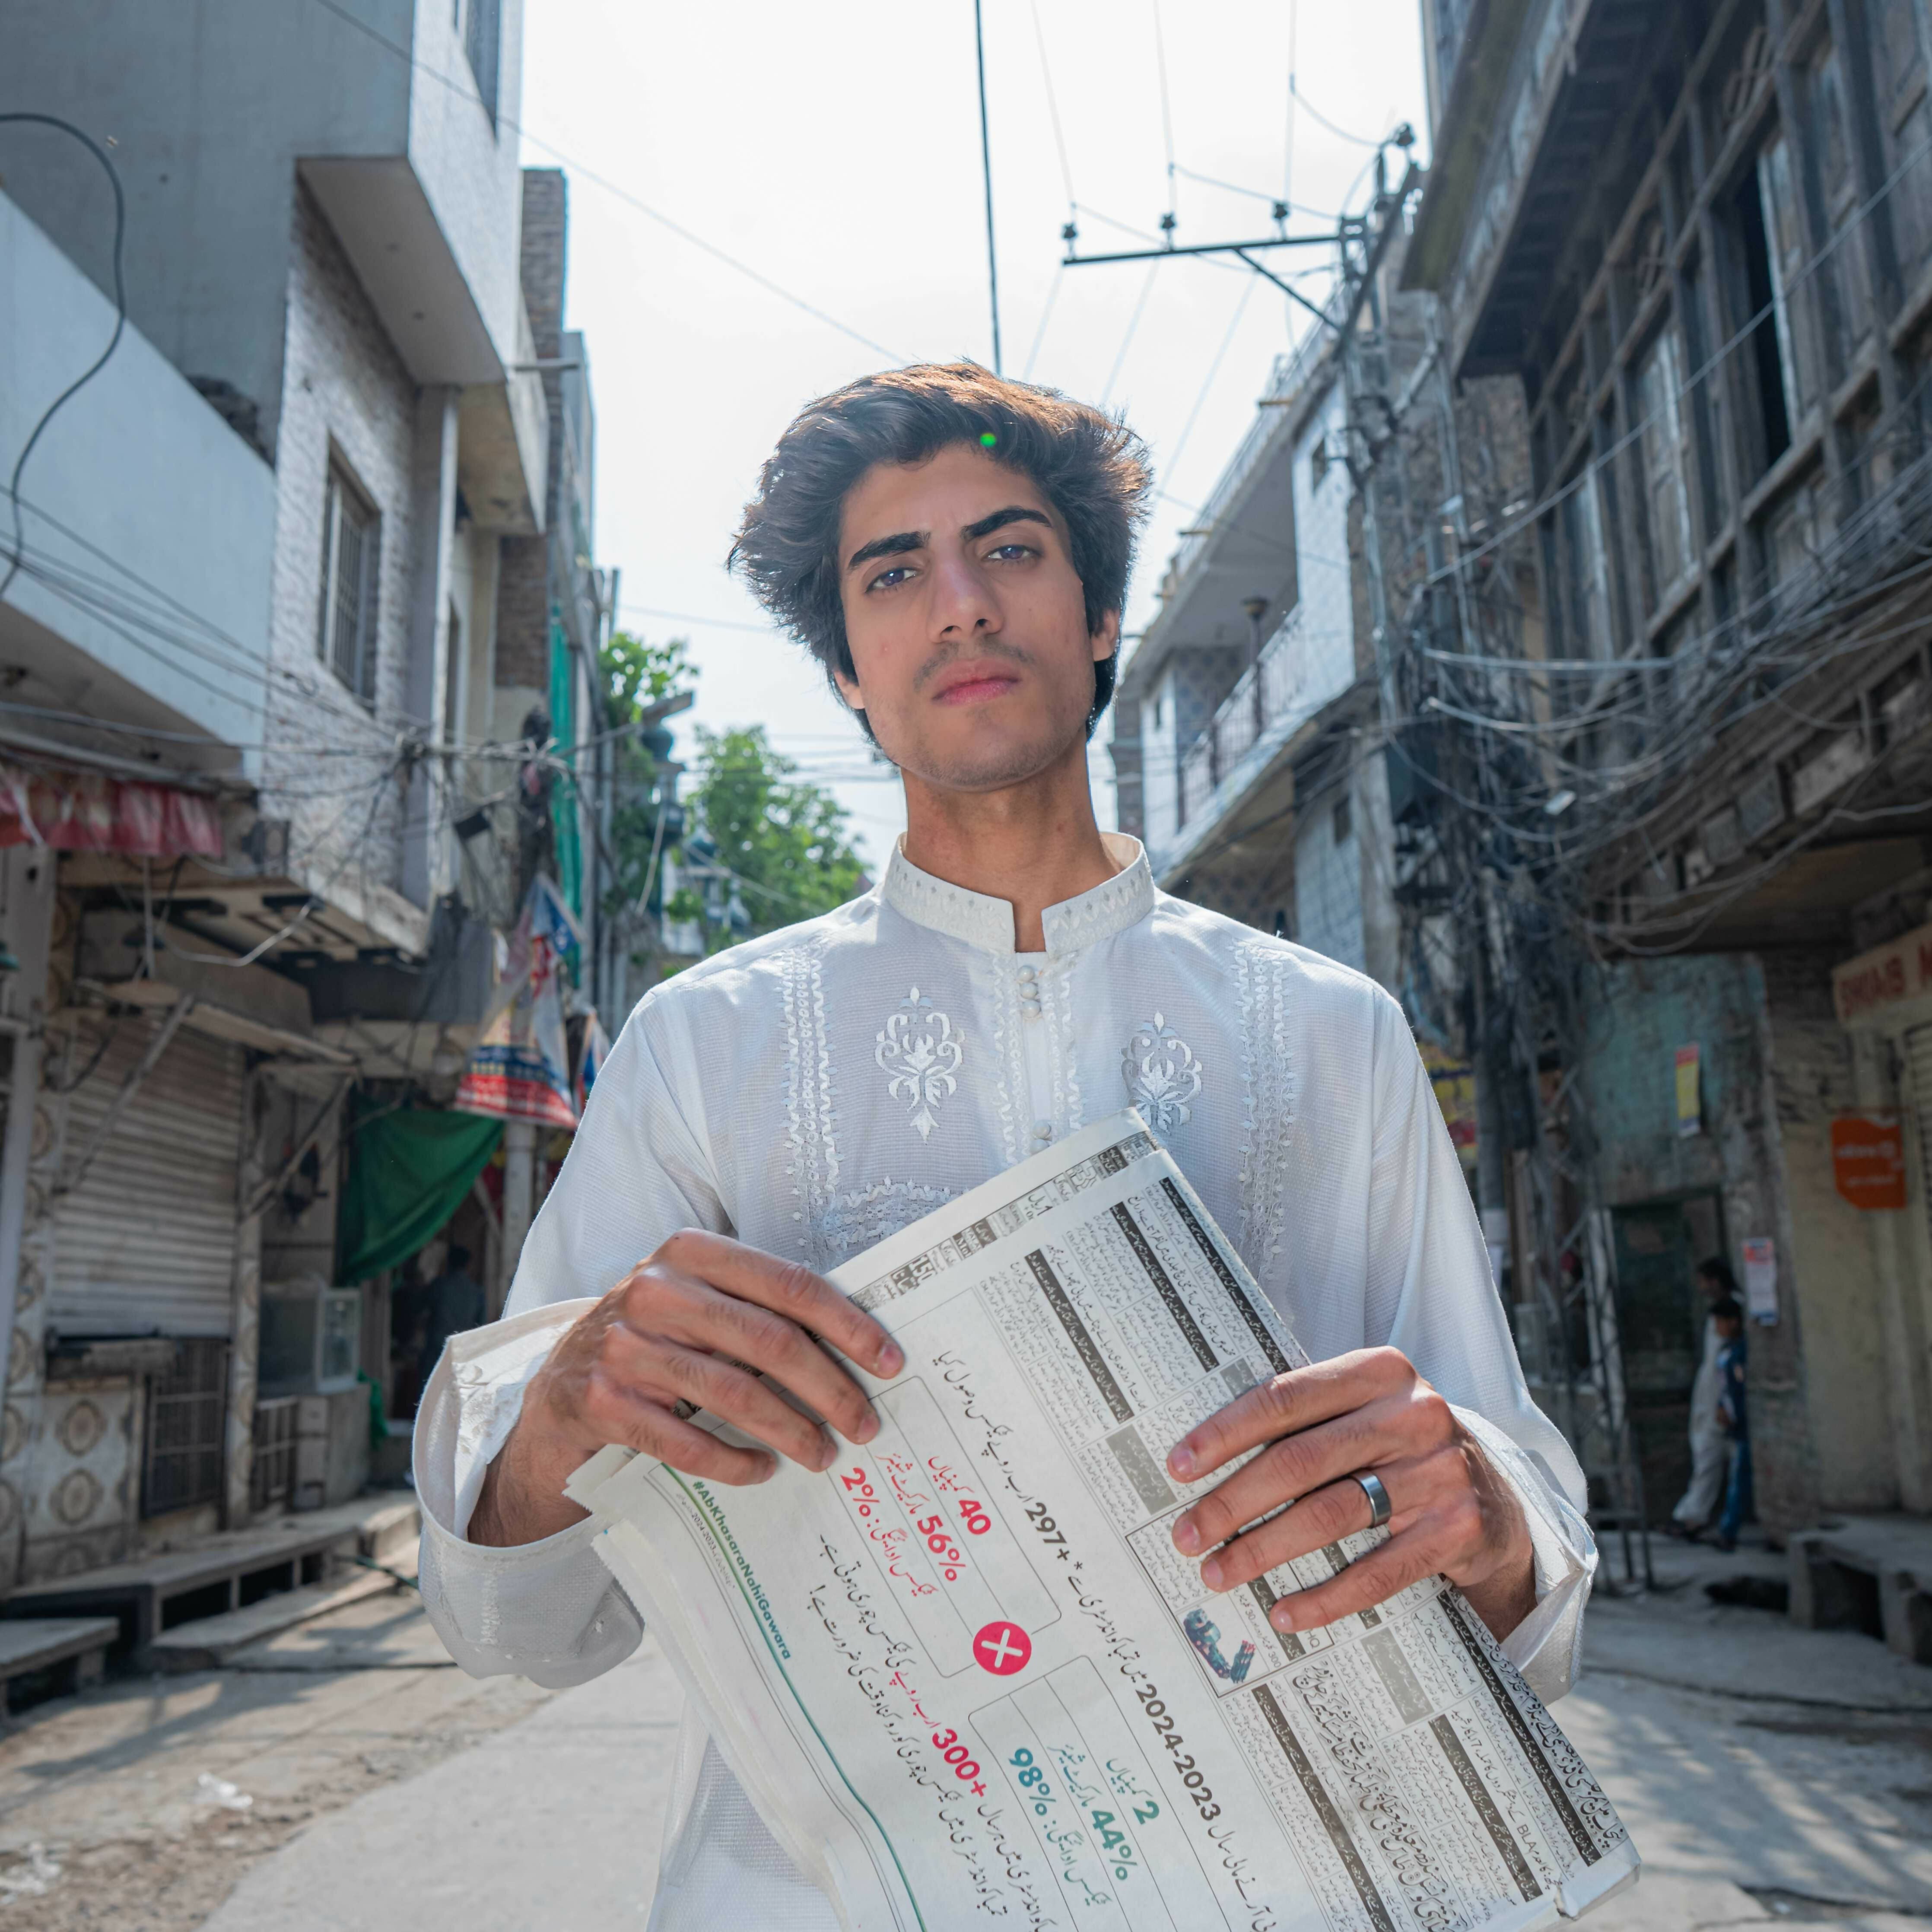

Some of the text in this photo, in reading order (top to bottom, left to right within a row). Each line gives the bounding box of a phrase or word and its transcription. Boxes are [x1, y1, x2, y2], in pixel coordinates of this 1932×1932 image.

[932, 1350, 963, 1366] کیا
[943, 1363, 975, 1406] وصول
[964, 1406, 1013, 1447] ٹیکس
[981, 1441, 1012, 1481] روپے
[840, 1467, 880, 1517] 2%
[891, 1478, 929, 1515] مارکیٹ
[928, 1456, 991, 1535] 40 کمپنیاں
[1005, 1479, 1034, 1503] ارب
[1025, 1502, 1070, 1561] 297+
[917, 1515, 966, 1582] 56%
[684, 1477, 791, 1660] #AbKhasaraNahiGawara
[833, 1560, 861, 1589] ہوتی
[889, 1565, 938, 1597] ٹیکس
[847, 1590, 876, 1624] چوری
[1078, 1596, 1116, 1637] انڈسٹری
[823, 1617, 861, 1661] ضرورت
[865, 1623, 912, 1665] ٹیکس
[1106, 1638, 1141, 1668] تمباکو
[847, 1665, 877, 1685] کی
[885, 1647, 915, 1675] کی
[1120, 1664, 1147, 1683] میں
[1268, 1651, 1281, 1668] 300
[858, 1680, 884, 1707] وقت
[889, 1671, 919, 1702] روپے
[912, 1703, 941, 1728] ارب
[896, 1747, 927, 1778] چوری
[932, 1729, 986, 1797] 300+
[1135, 1684, 1221, 1821] 2024-2023
[916, 1776, 963, 1803] ٹیکس
[1009, 1748, 1056, 1816] 98%
[1063, 1759, 1101, 1808] مارکیٹ
[1106, 1759, 1160, 1825] 2 کمپنیاں
[938, 1810, 964, 1830] میں
[977, 1804, 1003, 1835] سال
[996, 1843, 1022, 1865] میں
[1091, 1810, 1138, 1881] 44%
[1207, 1826, 1235, 1854] سال
[1516, 1824, 1537, 1853] BLA
[950, 1831, 987, 1886] انڈسٹری
[1223, 1856, 1248, 1877] مالی
[976, 1888, 1008, 1916] تمباکو
[1064, 1868, 1112, 1907] ٹیکس
[1235, 1877, 1255, 1901] نے
